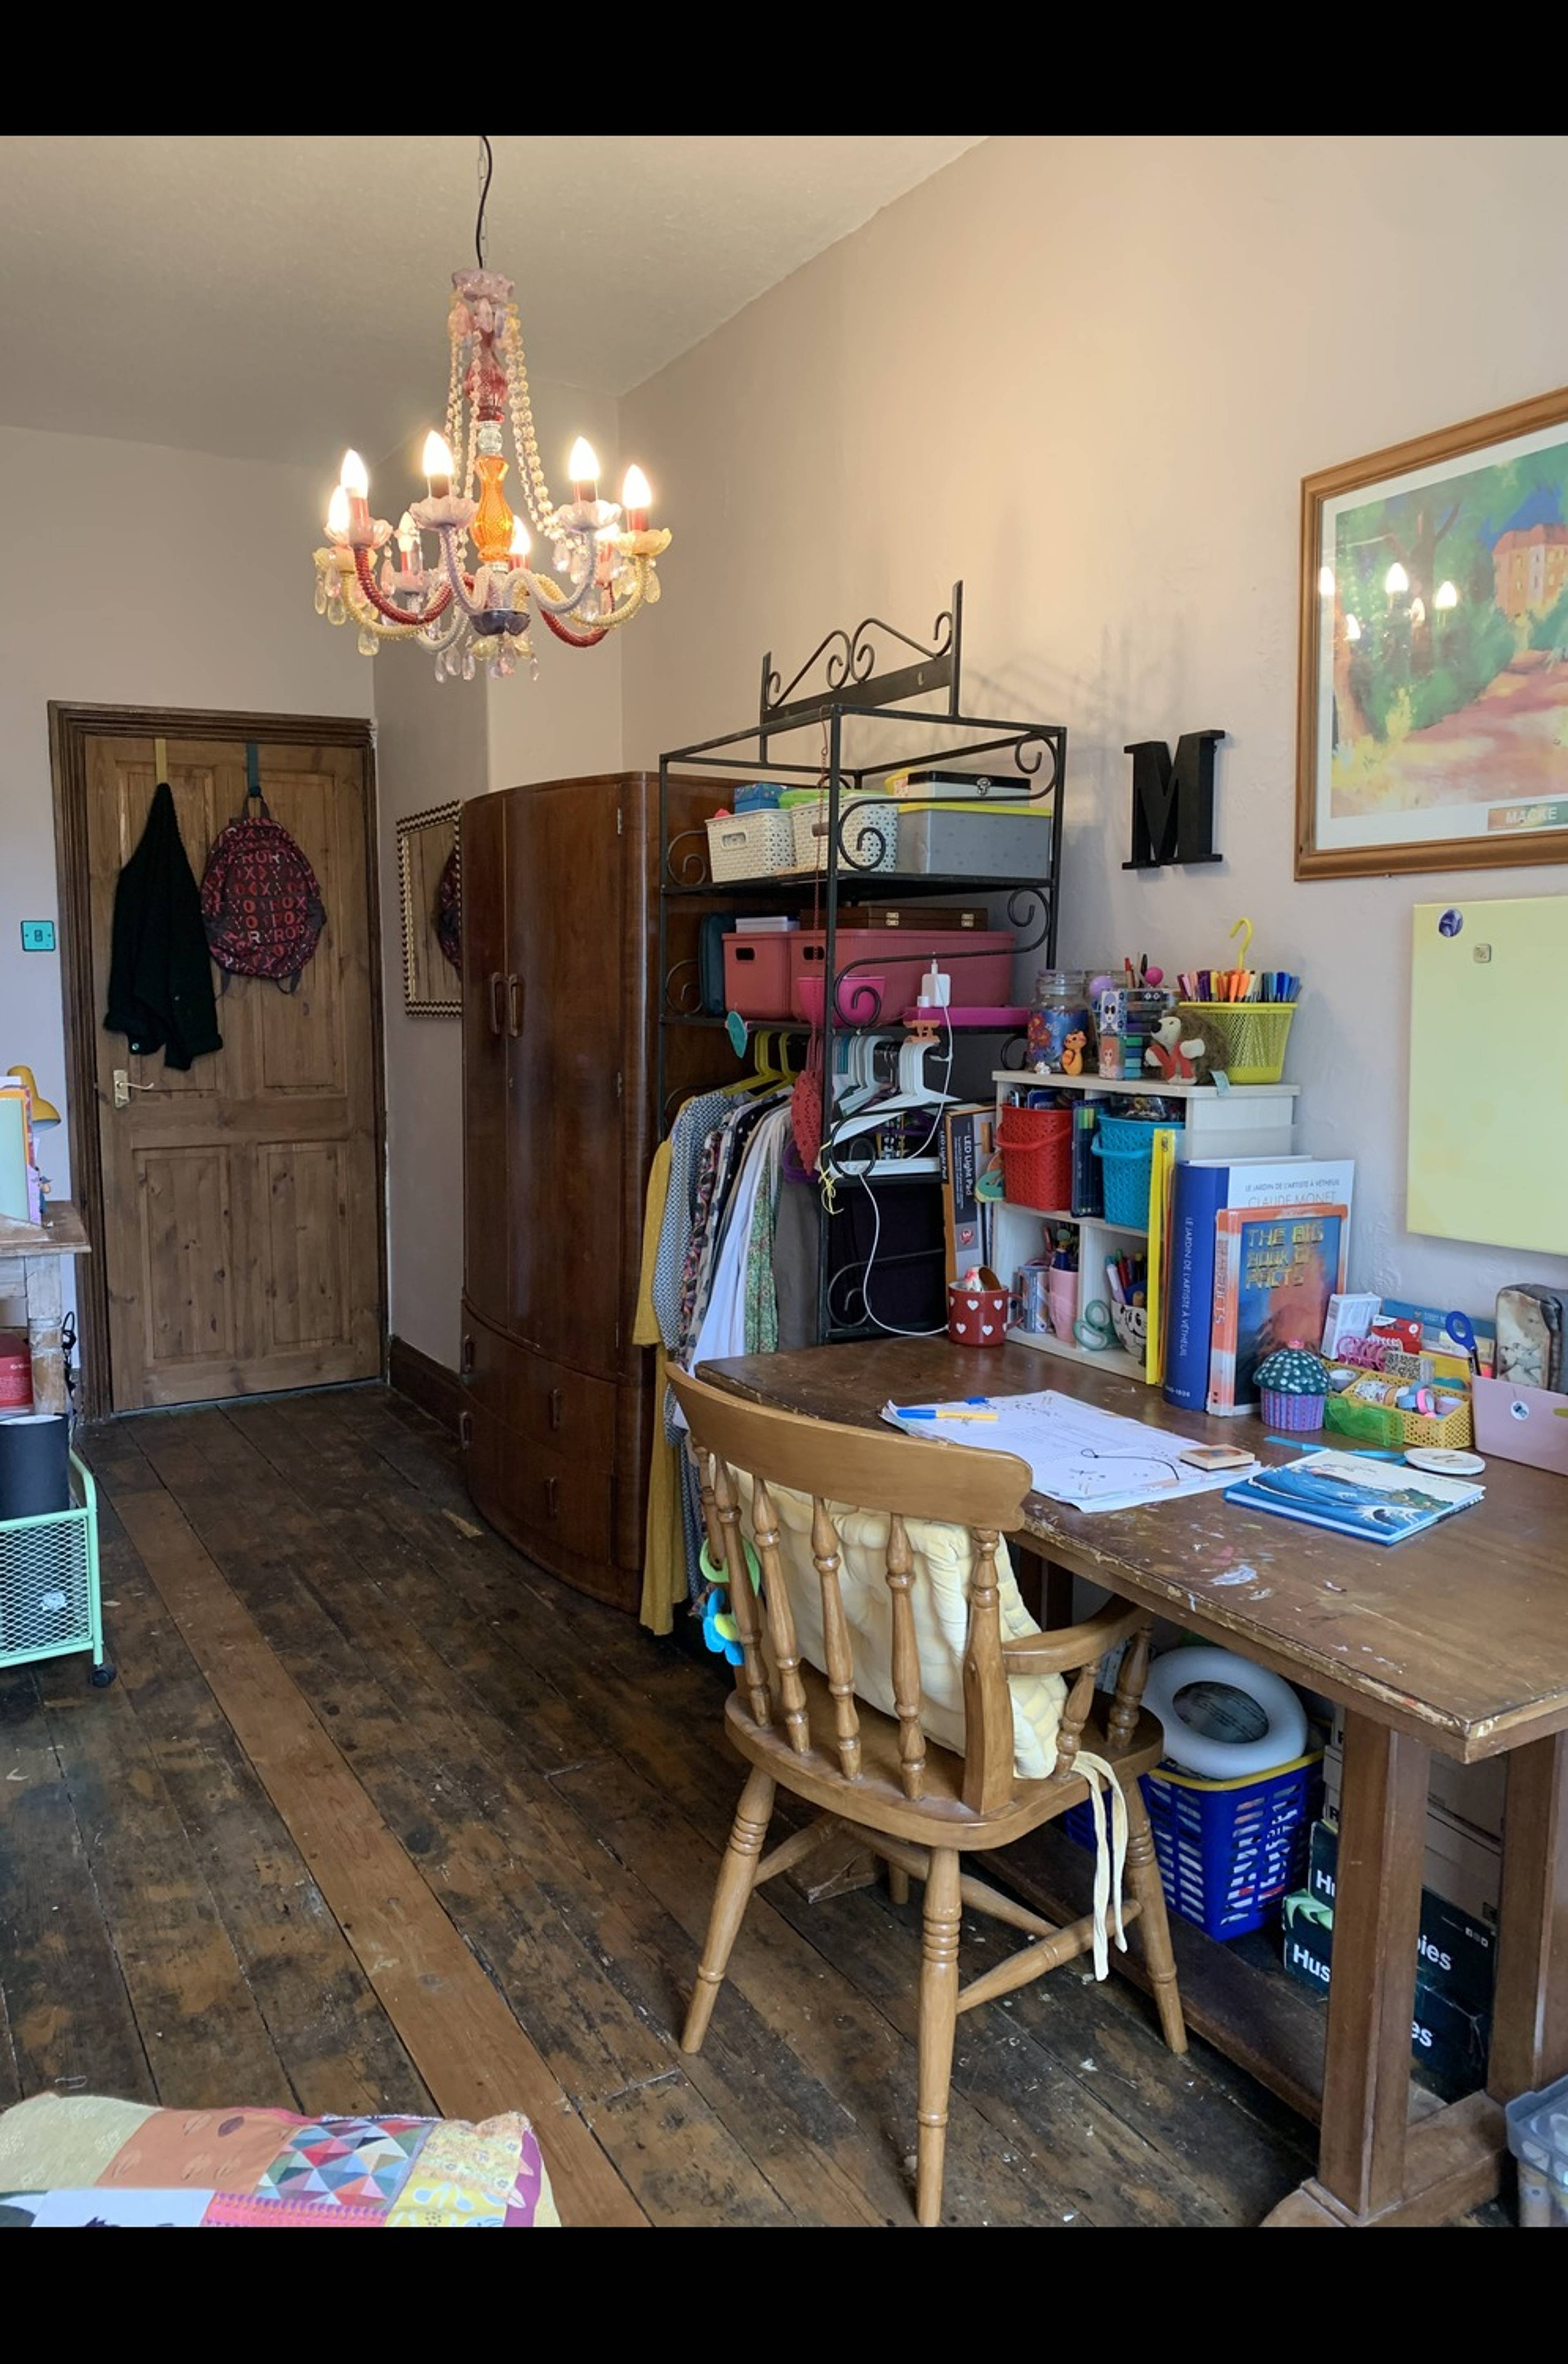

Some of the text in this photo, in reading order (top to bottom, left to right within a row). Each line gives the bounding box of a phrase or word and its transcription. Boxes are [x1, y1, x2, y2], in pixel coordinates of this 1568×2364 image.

[1122, 729, 1225, 871] M
[1506, 806, 1558, 824] MACKE
[963, 1155, 973, 1177] Light
[1185, 1217, 1194, 1225] LE
[1184, 1227, 1193, 1257] JARDIN
[1247, 1222, 1324, 1247] THE BIG
[1184, 1259, 1192, 1271] DE
[1247, 1249, 1289, 1269] BOOK
[1246, 1267, 1305, 1291] FACTS
[1292, 1944, 1331, 1983] Hus
